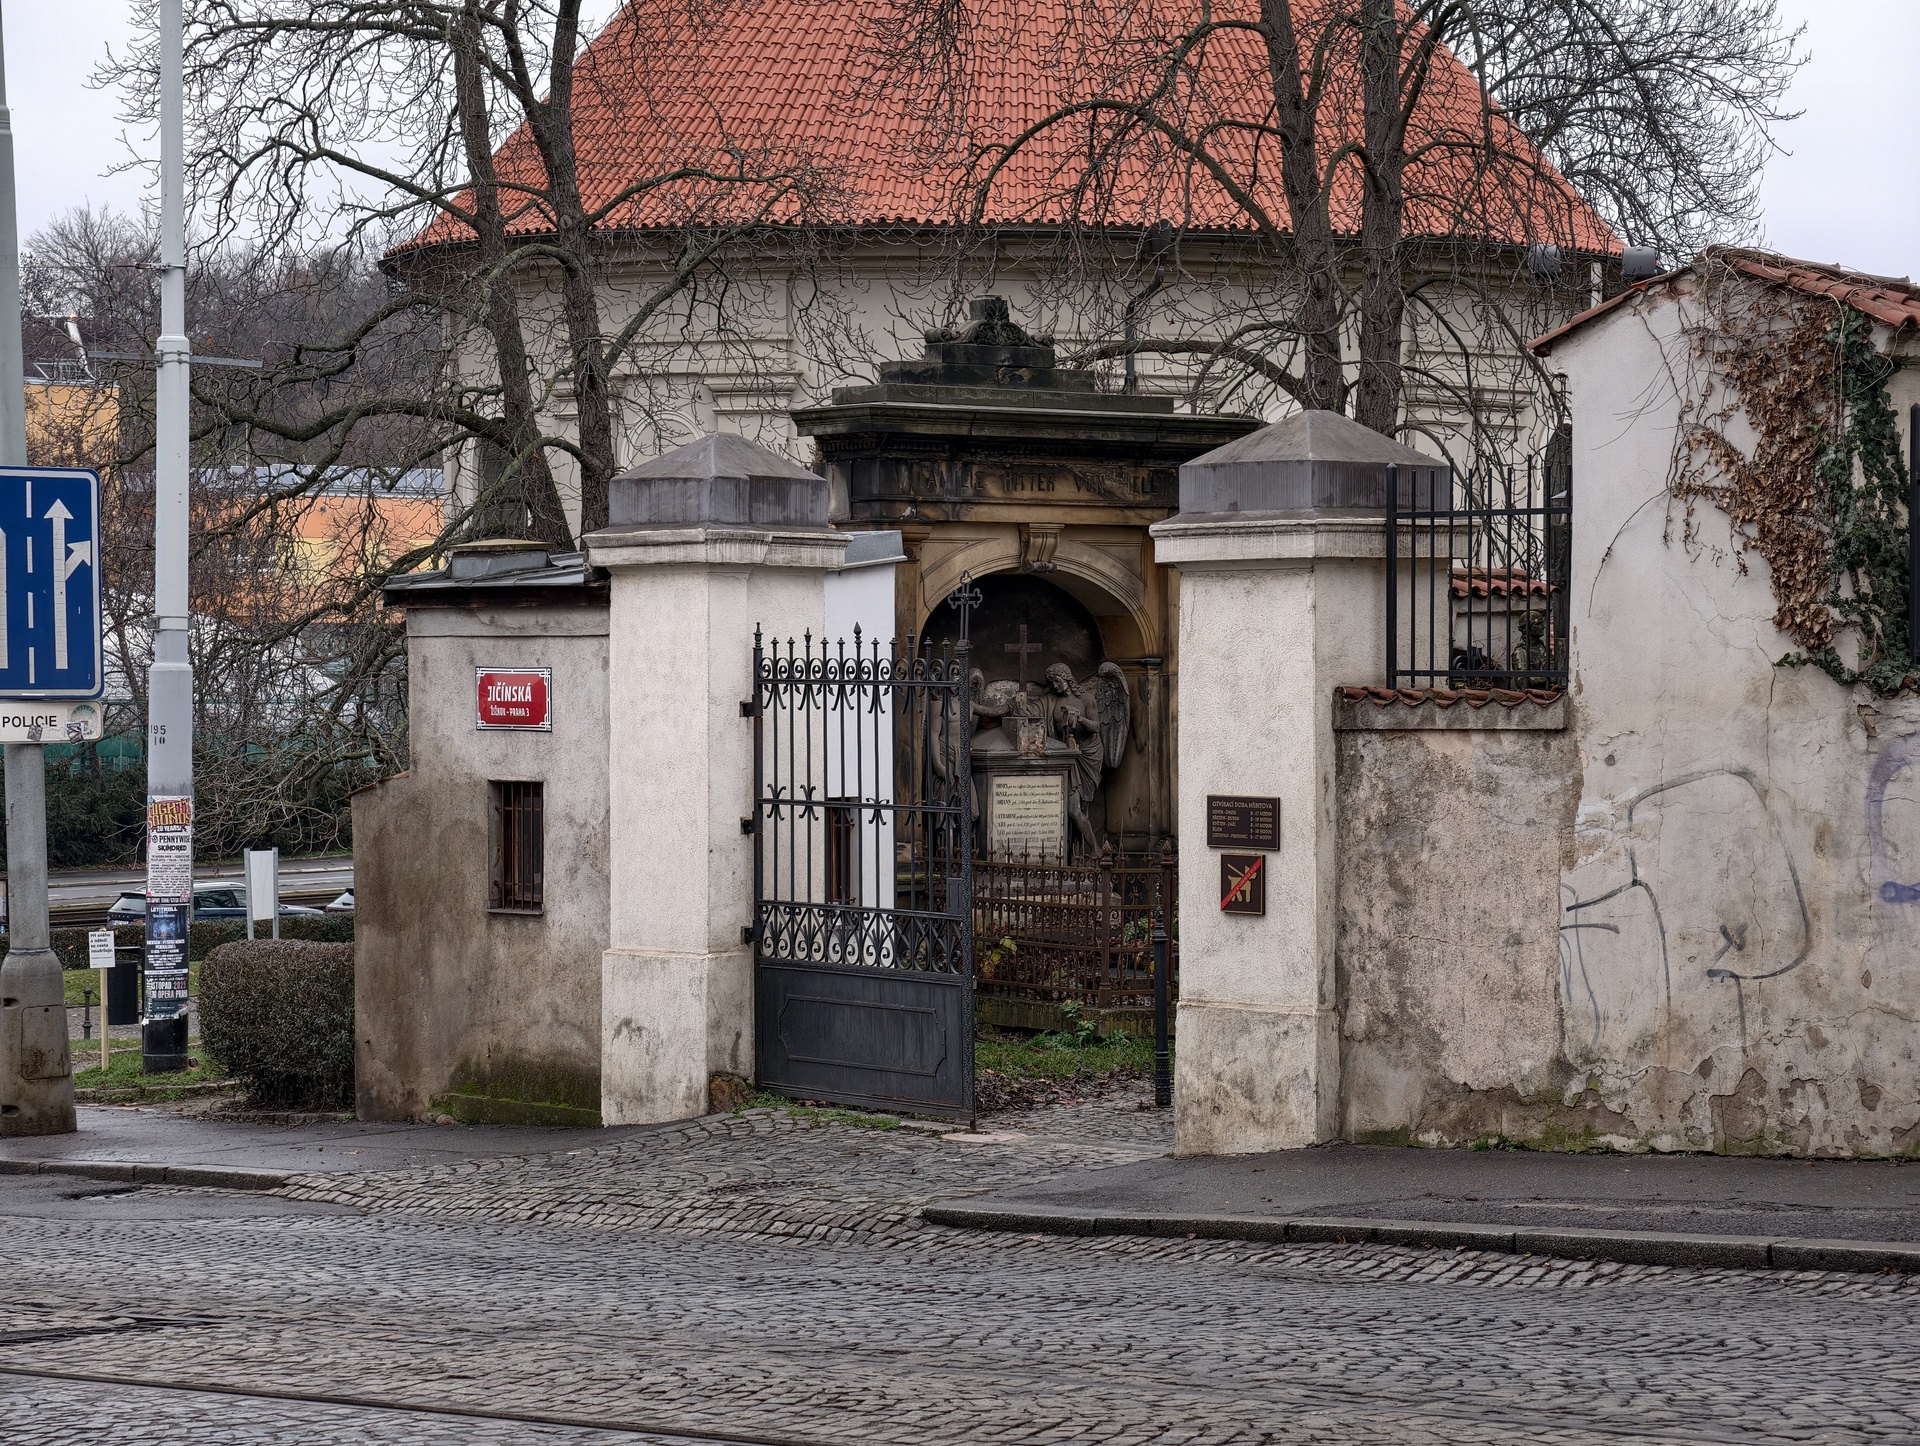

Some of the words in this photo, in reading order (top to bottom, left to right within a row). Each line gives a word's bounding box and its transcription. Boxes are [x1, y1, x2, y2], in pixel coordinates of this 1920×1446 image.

[1002, 468, 1055, 492] RITTER
[487, 682, 532, 702] JIČÍNSKÁ
[509, 707, 526, 717] PRAHA
[526, 708, 530, 717] 3
[2, 715, 58, 728] POLICIE
[1212, 800, 1234, 808] OTVÍRACÍ
[148, 812, 191, 829] SOUNDS
[159, 834, 191, 843] PENNYWISE
[157, 989, 175, 999] OPERA
